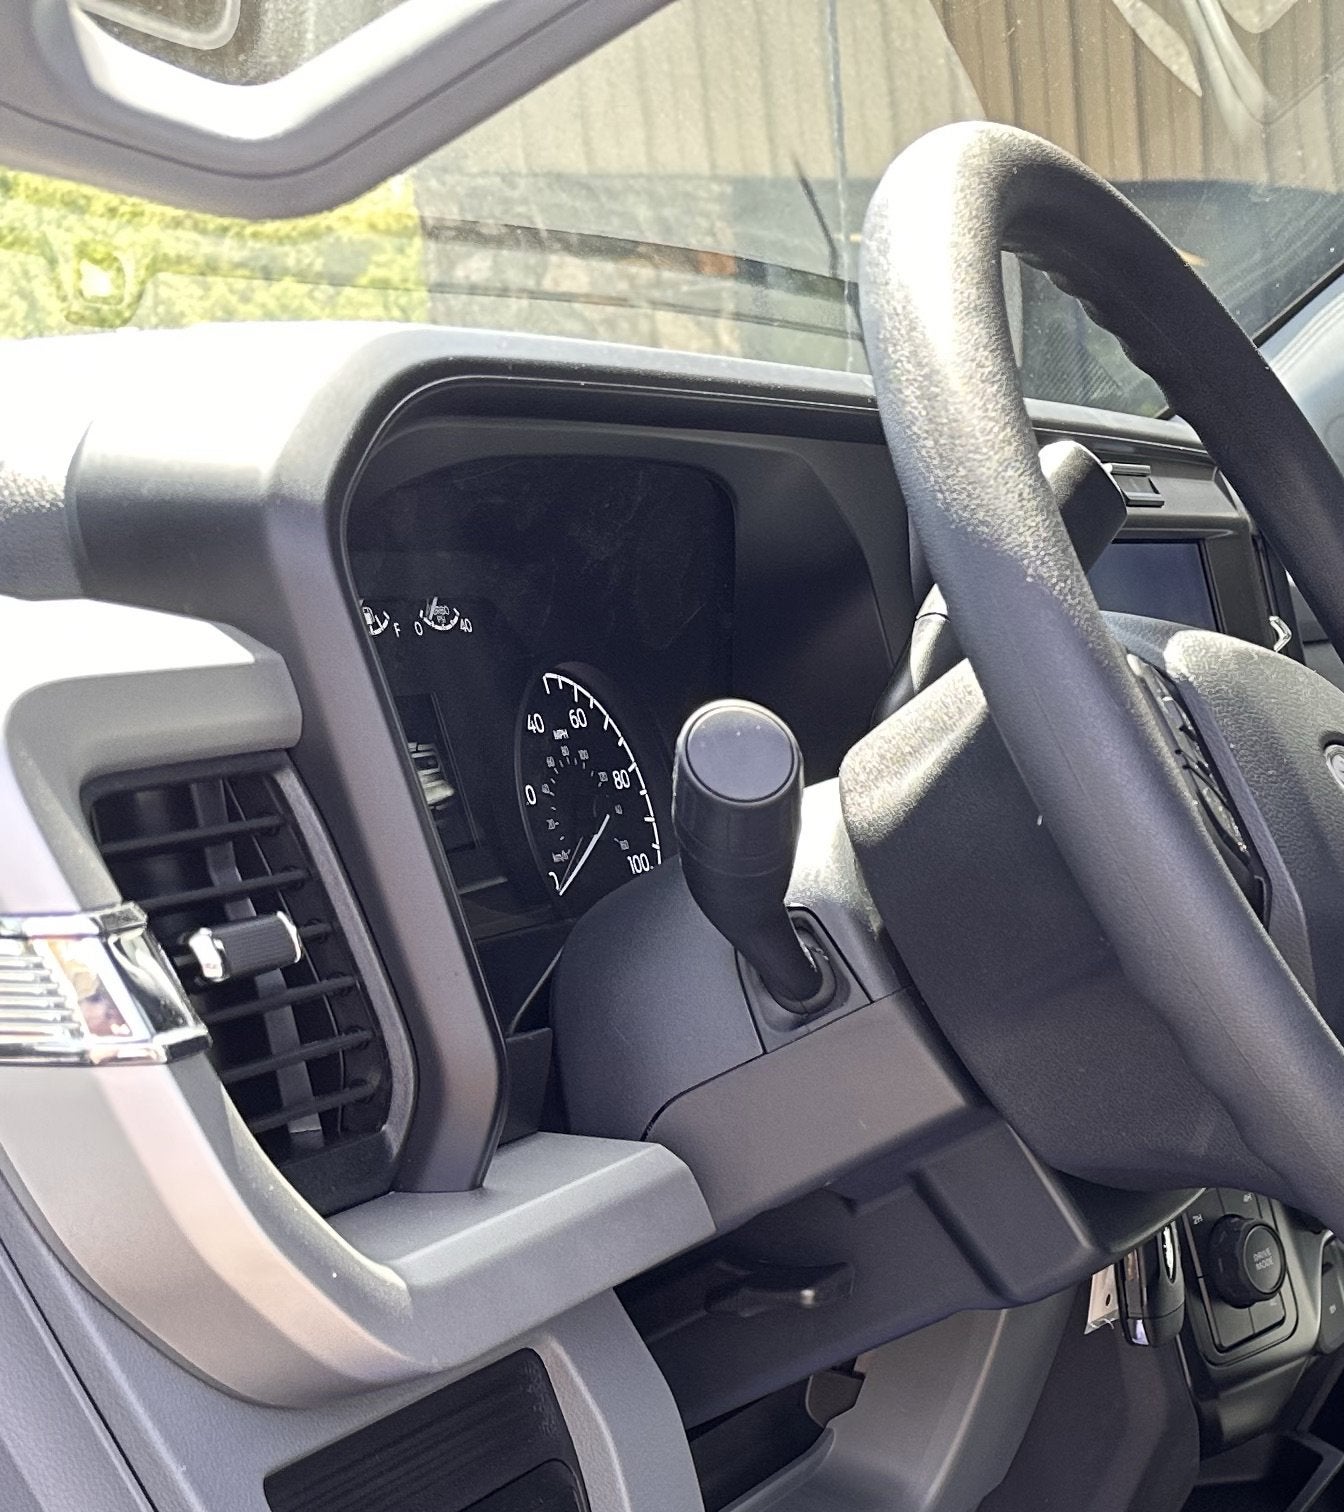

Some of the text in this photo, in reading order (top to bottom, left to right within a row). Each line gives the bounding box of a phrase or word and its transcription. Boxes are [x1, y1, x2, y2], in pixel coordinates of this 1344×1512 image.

[526, 712, 545, 734] 40
[568, 707, 588, 729] 60
[612, 769, 631, 790] 80
[626, 852, 650, 875] 100
